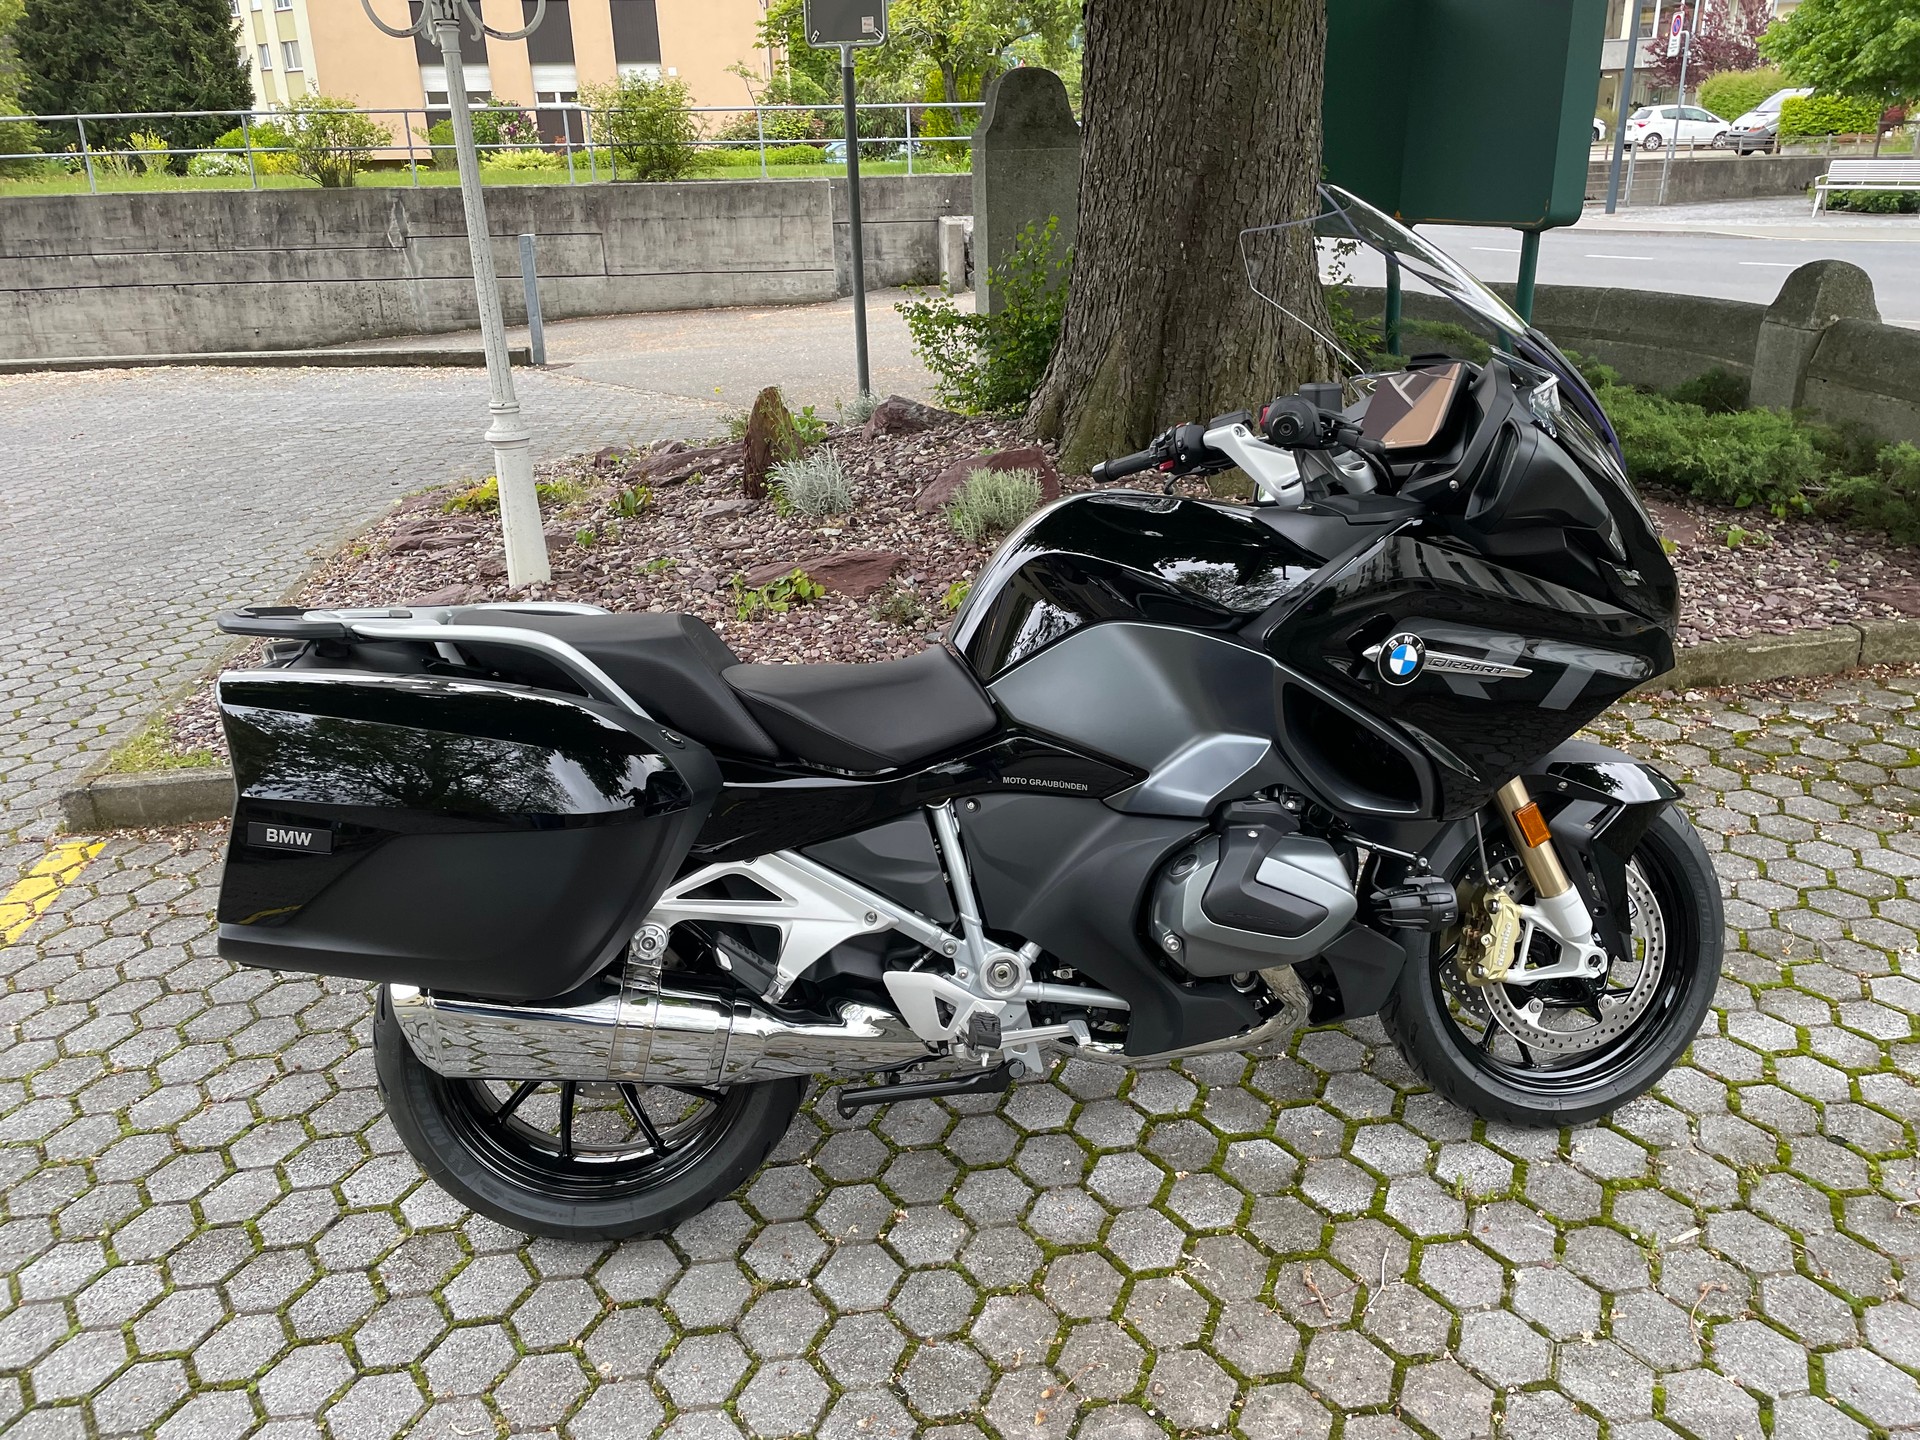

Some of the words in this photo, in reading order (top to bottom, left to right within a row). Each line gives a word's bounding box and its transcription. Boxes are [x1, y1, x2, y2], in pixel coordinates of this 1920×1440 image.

[1002, 776, 1027, 785] MOTO
[1029, 778, 1088, 791] GRAUBÜNDEN
[266, 828, 312, 846] BMW
[407, 1056, 450, 1147] MICHE
